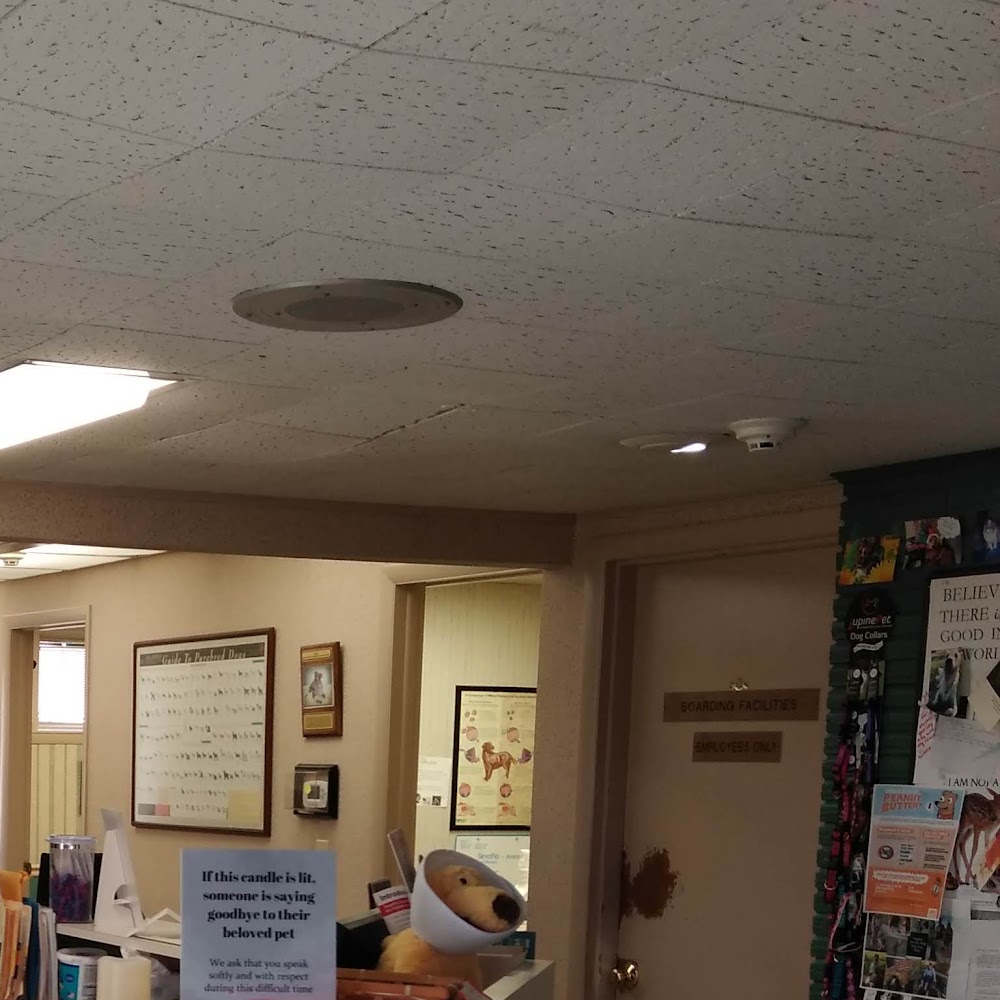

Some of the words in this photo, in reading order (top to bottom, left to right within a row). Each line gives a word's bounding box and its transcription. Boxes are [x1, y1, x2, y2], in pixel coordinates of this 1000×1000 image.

[943, 583, 1000, 602] BELIEV
[940, 607, 989, 623] THERE
[850, 632, 864, 641] Dog
[864, 631, 889, 640] Collars
[940, 628, 984, 643] GOOD
[680, 700, 735, 713] BOARDING
[738, 698, 798, 712] FACILITIES
[953, 778, 969, 786] AM
[202, 870, 214, 882] If
[215, 871, 239, 883] this
[241, 872, 283, 884] candle
[285, 872, 296, 884] is
[203, 892, 259, 902] someone
[261, 890, 272, 902] is
[274, 891, 316, 905] saying
[207, 908, 260, 923] goodbye
[262, 911, 276, 921] to
[278, 909, 311, 921] their
[223, 926, 272, 939] beloved
[274, 928, 295, 941] pet
[209, 958, 225, 968] We
[226, 958, 242, 968] ask
[243, 958, 262, 968] that
[264, 961, 281, 970] you
[283, 959, 308, 970] speak
[208, 970, 233, 981] softly
[235, 971, 252, 980] and
[255, 971, 275, 981] with
[277, 973, 309, 982] respect
[204, 984, 234, 995] during
[236, 984, 253, 993] this
[255, 984, 291, 993] difficult
[293, 984, 313, 993] time
